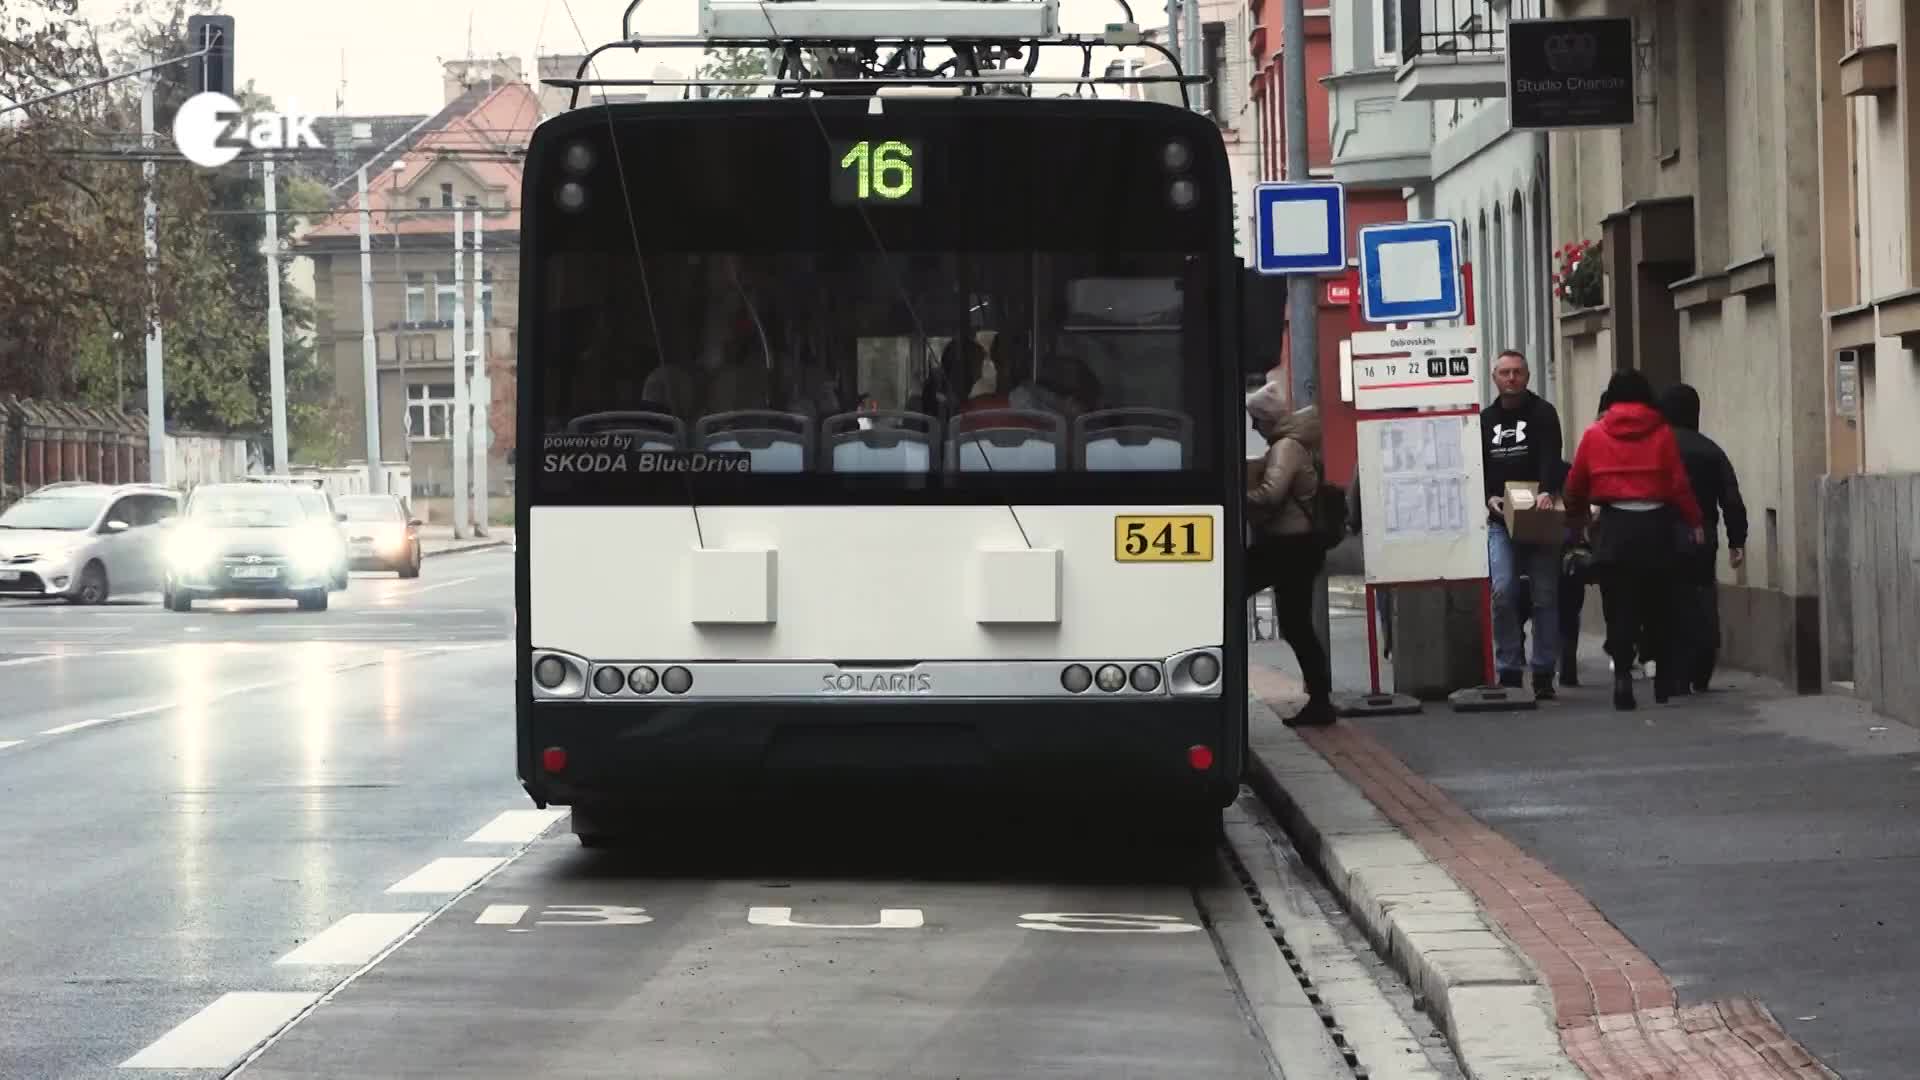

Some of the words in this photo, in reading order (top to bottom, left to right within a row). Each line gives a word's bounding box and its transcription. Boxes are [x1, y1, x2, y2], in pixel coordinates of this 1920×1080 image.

[1516, 78, 1562, 93] Studio
[841, 140, 913, 199] 16
[1364, 366, 1375, 378] 16
[1386, 365, 1397, 376] 19
[1408, 362, 1420, 374] 22
[1431, 361, 1444, 374] N1
[1452, 360, 1467, 373] N4
[543, 433, 609, 449] powered
[613, 434, 632, 449] by
[638, 453, 750, 472] BlueDrive
[1125, 521, 1201, 556] 541
[822, 673, 932, 692] SOLARIS
[474, 904, 1202, 933] BUS
